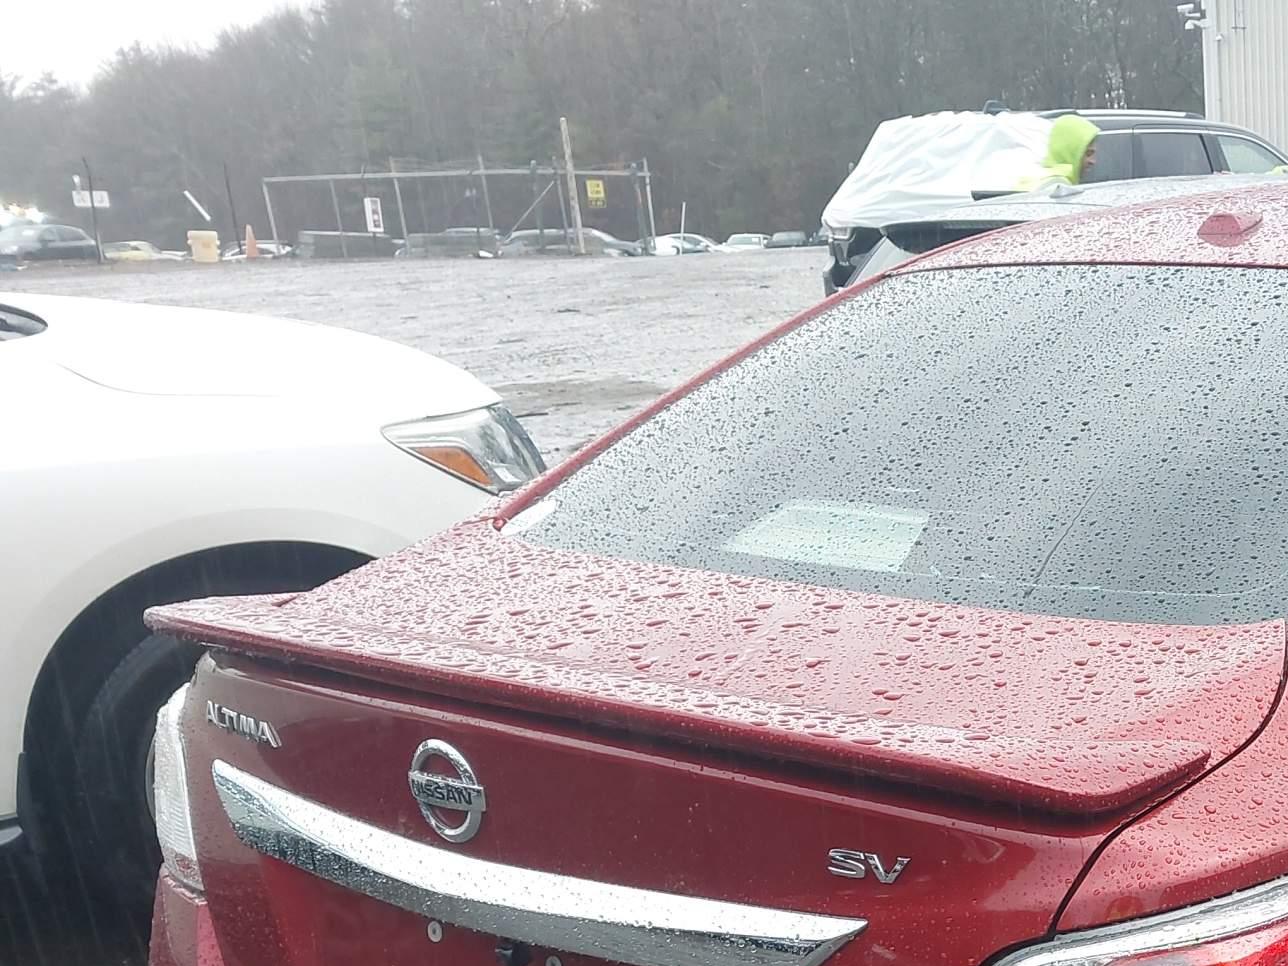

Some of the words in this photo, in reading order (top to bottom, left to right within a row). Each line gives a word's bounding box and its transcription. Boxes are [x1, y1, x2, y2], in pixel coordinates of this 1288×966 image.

[206, 700, 282, 748] ALTIMA
[412, 780, 473, 806] NISSAN
[828, 848, 911, 884] SV
